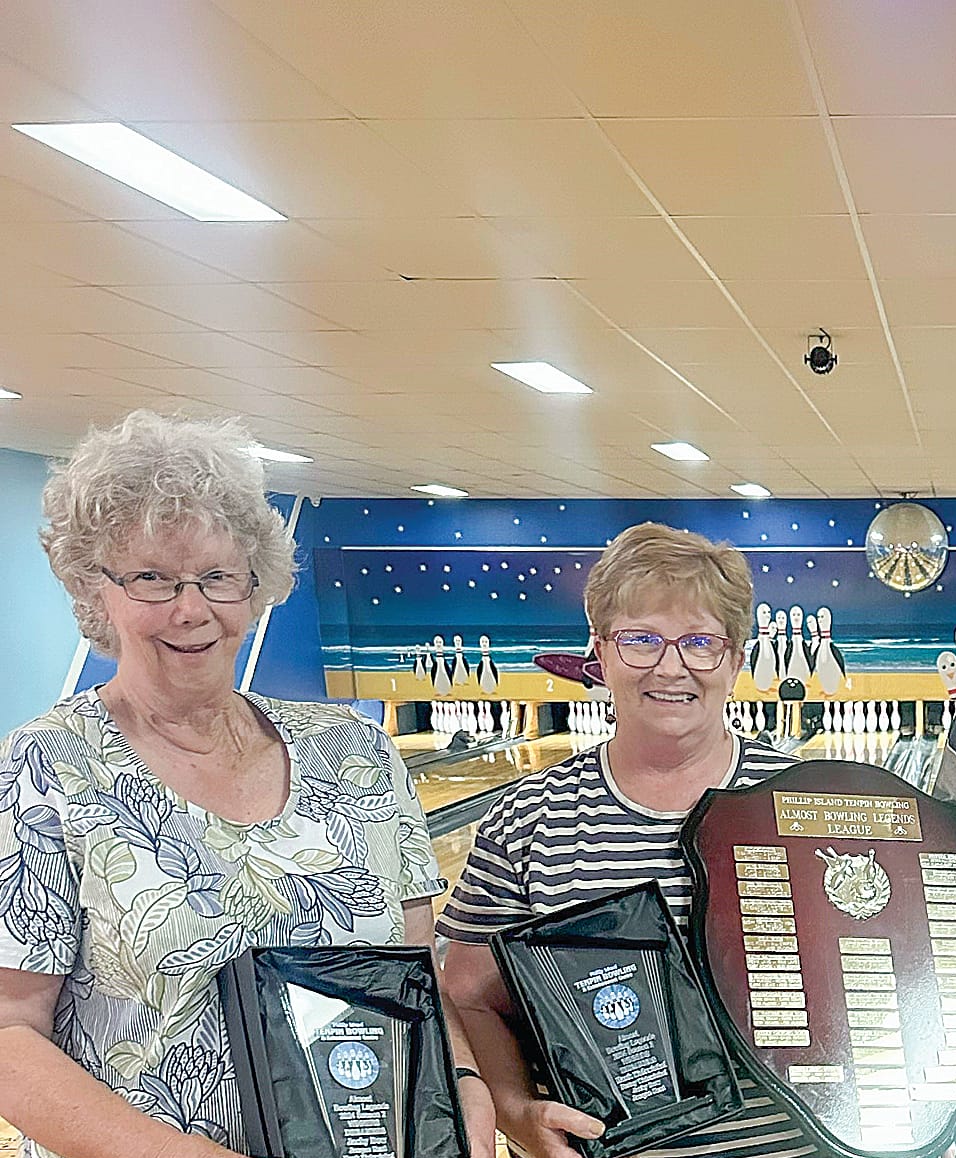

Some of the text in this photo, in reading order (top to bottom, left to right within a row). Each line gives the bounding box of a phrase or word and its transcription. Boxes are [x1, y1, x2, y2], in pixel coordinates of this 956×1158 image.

[391, 679, 397, 692] 1
[546, 679, 554, 692] 2
[781, 796, 910, 810] PHILLIP ISLAND TENPIN BOWLING
[780, 809, 916, 825] ALMOST BOWLING LEGENDS
[827, 824, 873, 836] LEAGUE
